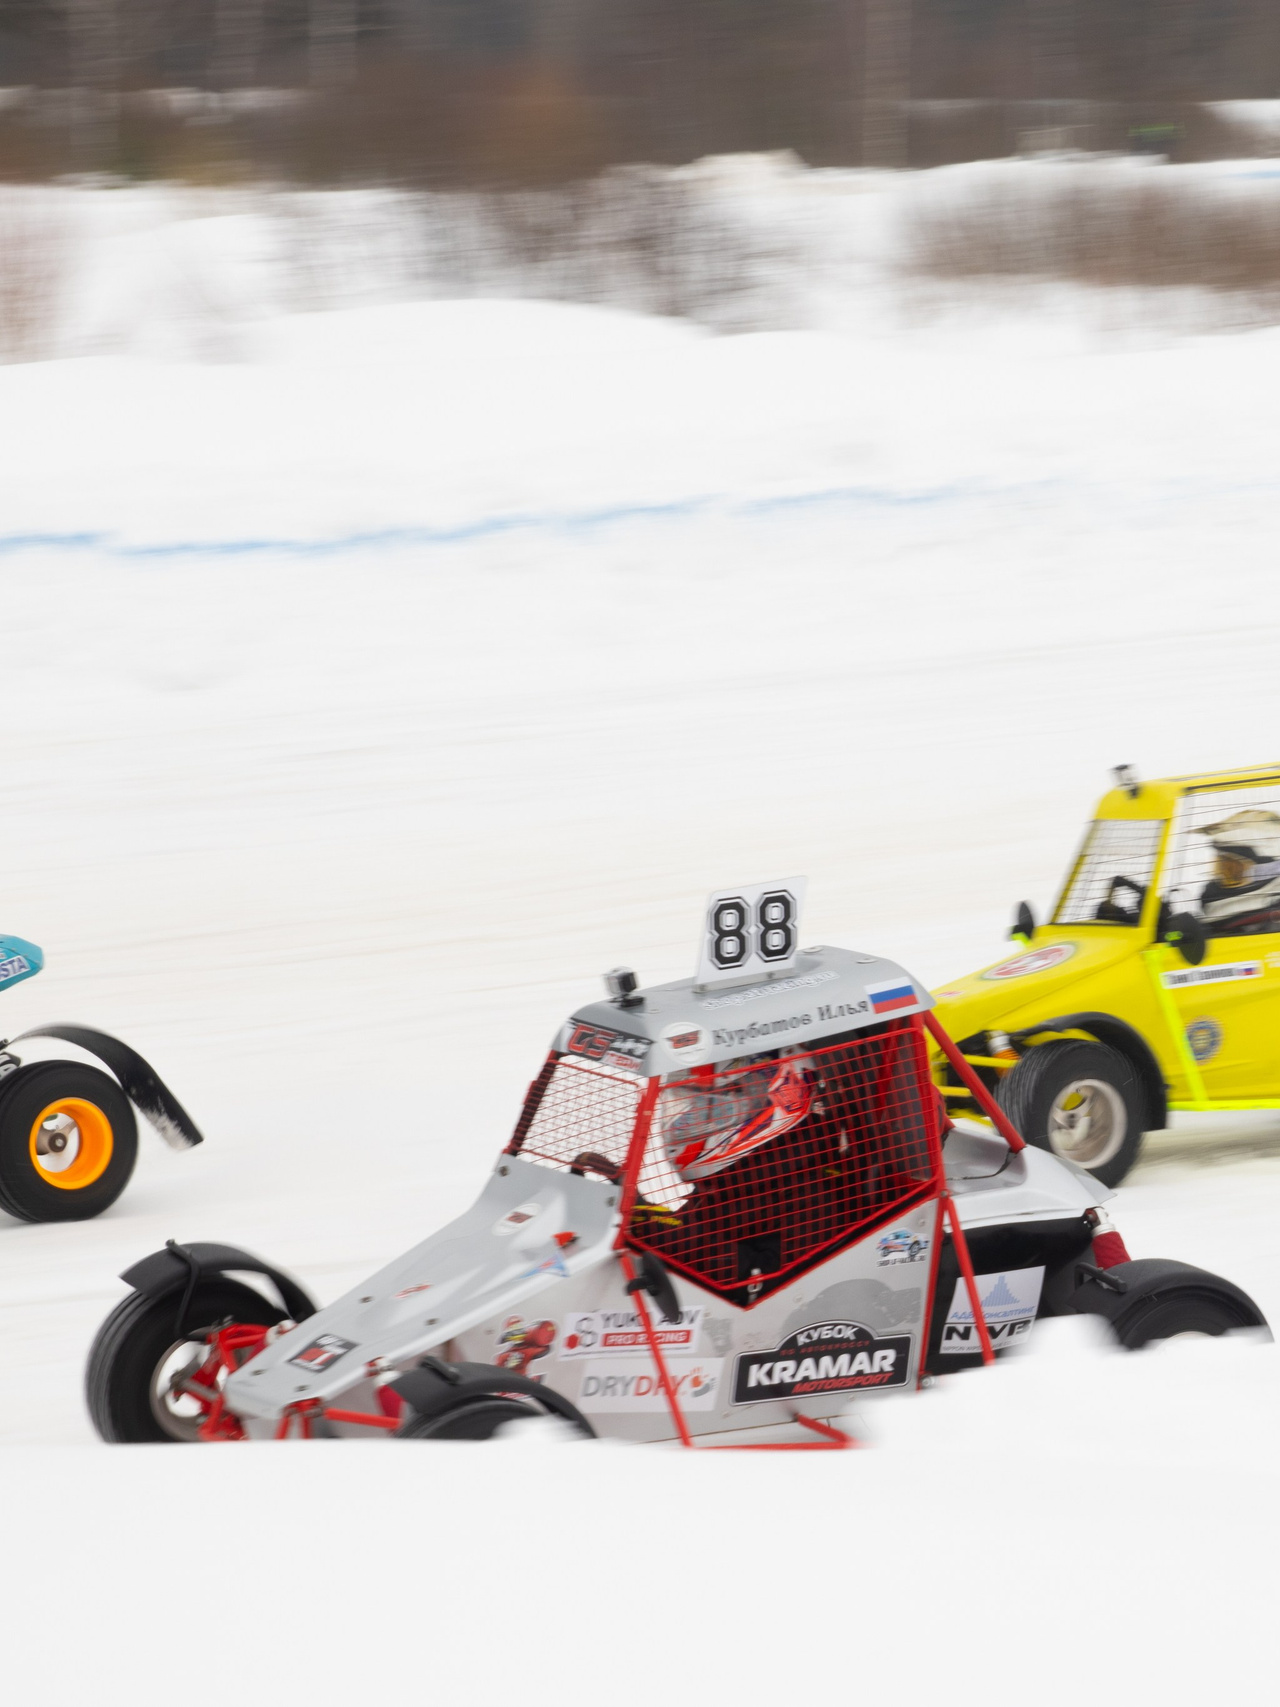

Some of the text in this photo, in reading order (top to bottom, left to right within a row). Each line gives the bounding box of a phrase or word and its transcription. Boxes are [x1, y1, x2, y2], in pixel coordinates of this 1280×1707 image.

[708, 889, 798, 970] 88
[712, 1013, 812, 1048] Курбатов
[817, 1000, 869, 1021] Илья
[605, 1331, 688, 1346] PRO RCING
[797, 1325, 860, 1346] КУБОК
[747, 1349, 897, 1388] KRAMAR
[791, 1372, 894, 1395] MOTORSPORT
